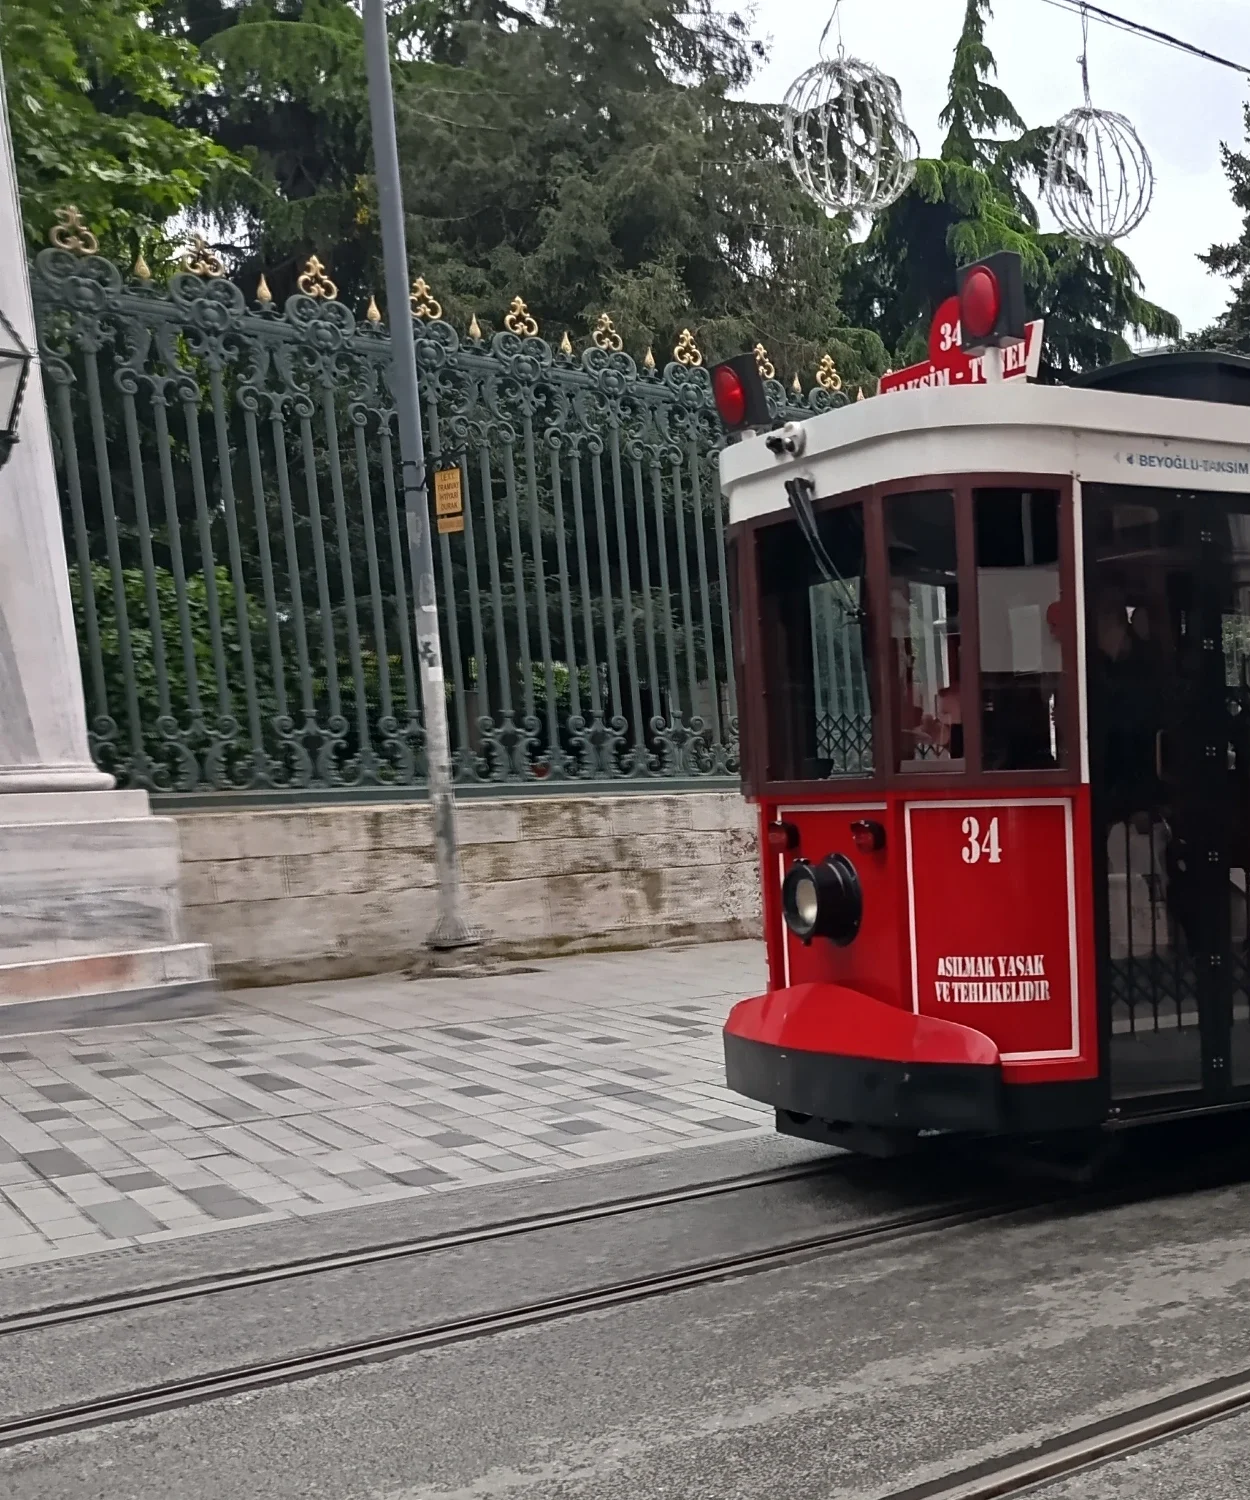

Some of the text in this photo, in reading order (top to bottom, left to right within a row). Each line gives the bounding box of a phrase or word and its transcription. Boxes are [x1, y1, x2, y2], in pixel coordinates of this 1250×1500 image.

[939, 320, 962, 351] 34
[961, 816, 1002, 864] 34
[937, 955, 1045, 977] ASILMAK YASAK
[934, 981, 951, 1002] VE
